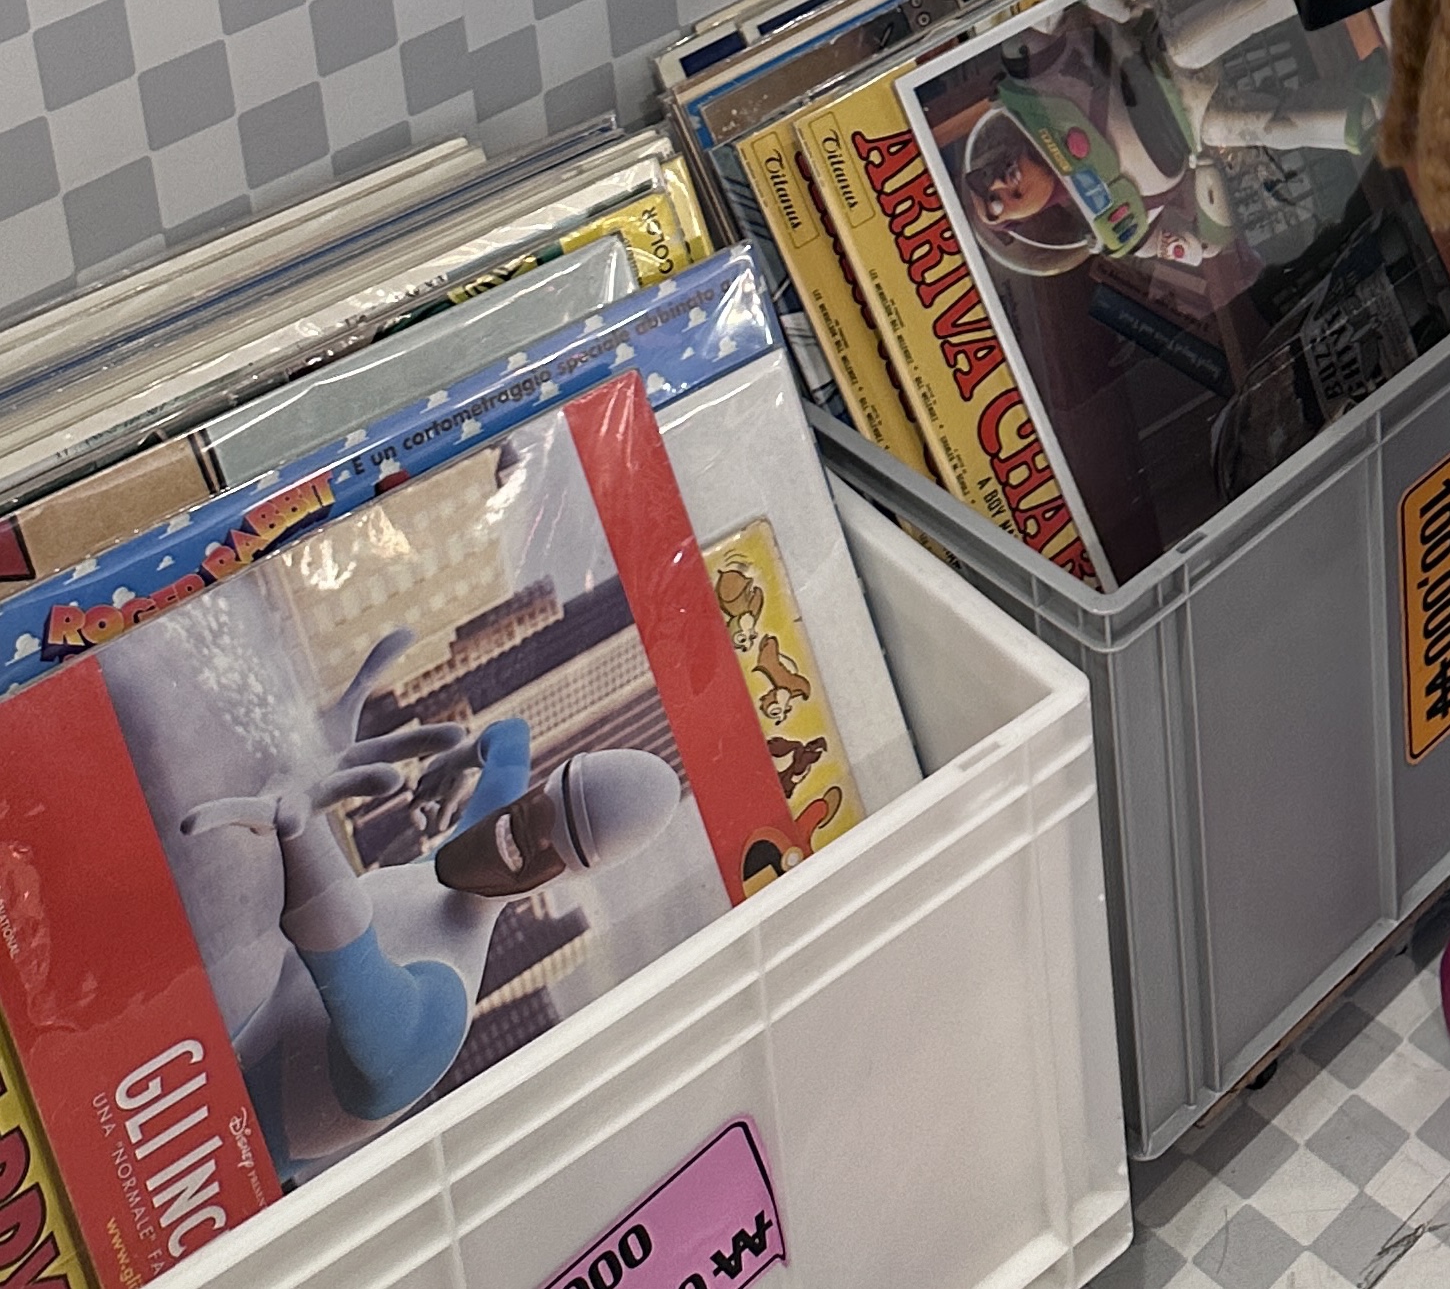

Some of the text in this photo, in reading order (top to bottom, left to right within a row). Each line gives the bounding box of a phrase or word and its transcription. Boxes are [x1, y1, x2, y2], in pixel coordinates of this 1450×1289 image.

[764, 149, 802, 232] Titanus
[821, 128, 859, 211] Titanus
[640, 207, 673, 275] COLOR
[852, 129, 1011, 402] ARRIVA
[371, 445, 396, 466] un
[402, 366, 552, 452] cortometraggio
[556, 327, 632, 377] speciale
[637, 286, 715, 337] abbinato
[983, 490, 1006, 519] BOY
[92, 1092, 115, 1138] UNA
[114, 1141, 157, 1241] "NORMALE"
[116, 1038, 228, 1260] GLI INC
